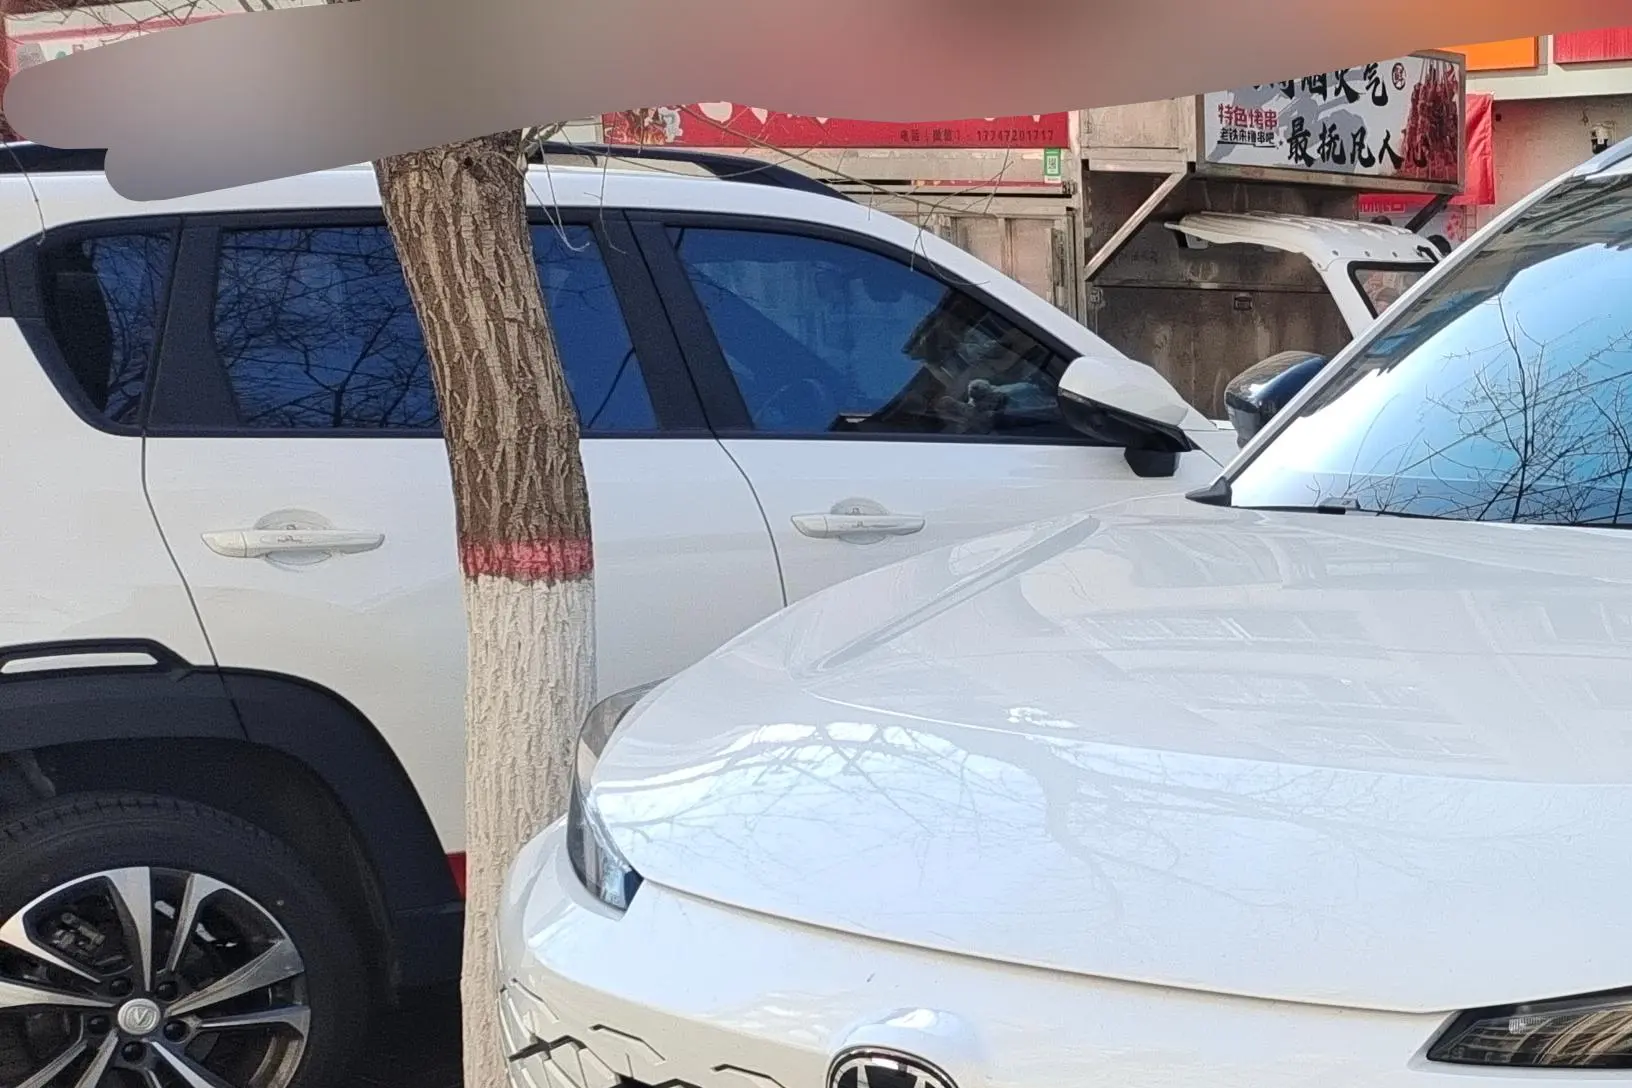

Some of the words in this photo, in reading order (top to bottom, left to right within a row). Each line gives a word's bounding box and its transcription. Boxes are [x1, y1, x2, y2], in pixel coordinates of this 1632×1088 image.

[1253, 62, 1389, 107] 烟火气
[1218, 104, 1277, 130] 特色烤串
